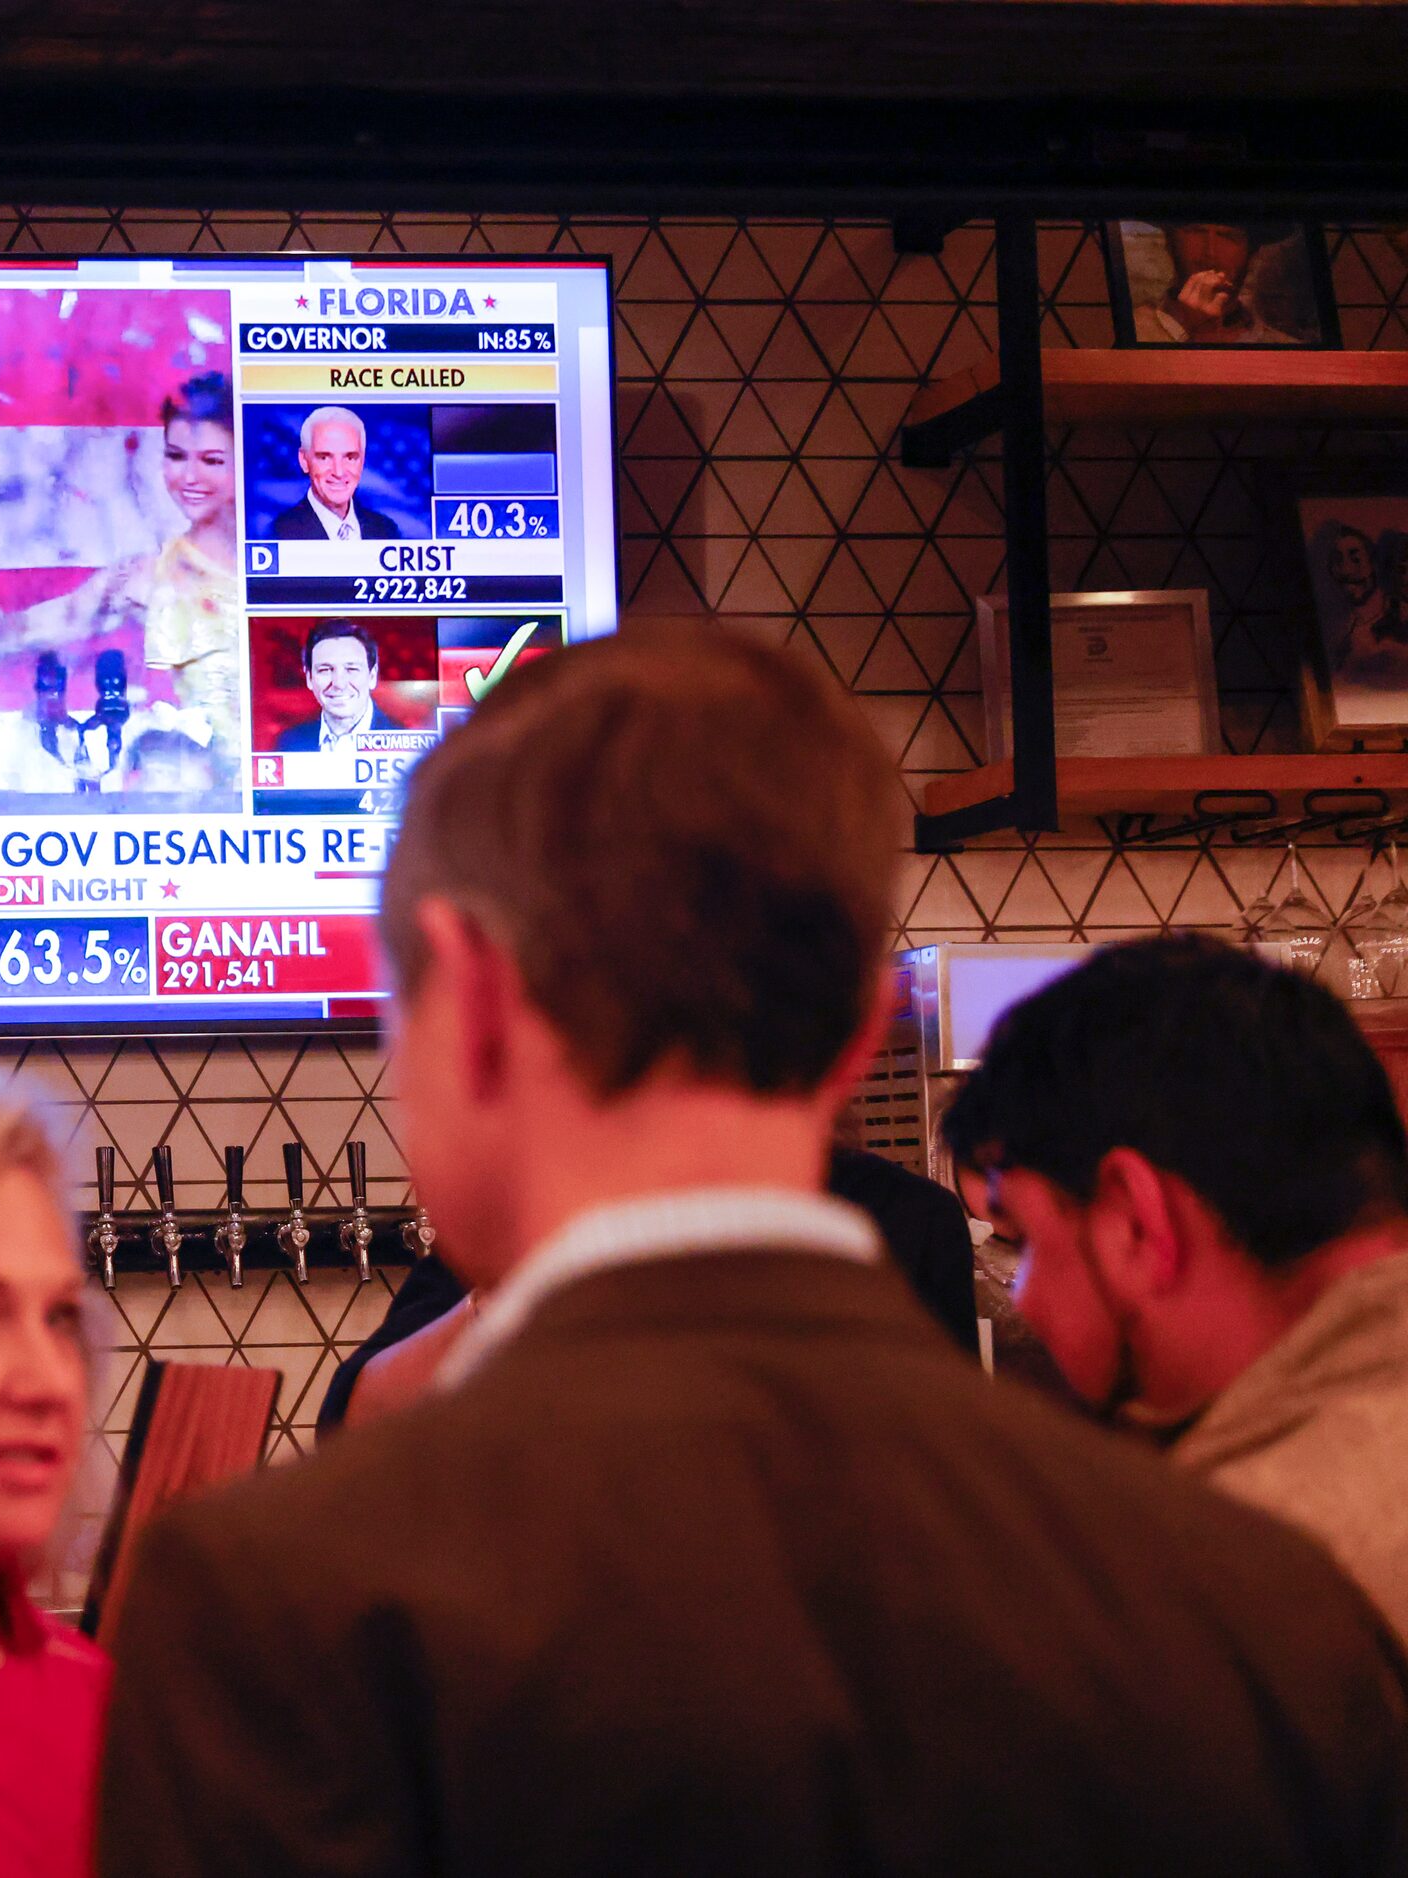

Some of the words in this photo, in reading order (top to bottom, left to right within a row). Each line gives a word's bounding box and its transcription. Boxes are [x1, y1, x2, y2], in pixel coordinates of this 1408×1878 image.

[320, 288, 476, 316] FLORIDA
[247, 326, 387, 351] GOVERNOR
[329, 369, 384, 388] RACE
[391, 368, 466, 388] CALLED
[448, 502, 548, 539] 40.3%
[251, 546, 274, 571] D
[379, 546, 456, 572] CRIST
[353, 577, 467, 602] 2,922,842
[357, 734, 435, 750] INCUMBENT
[257, 758, 279, 784] R
[1, 830, 98, 867] GOV
[114, 828, 307, 866] DESANTIS
[322, 828, 398, 863] RE-
[51, 878, 147, 902] NIGHT
[161, 921, 326, 957] GANAHL
[162, 960, 276, 992] 291,541
